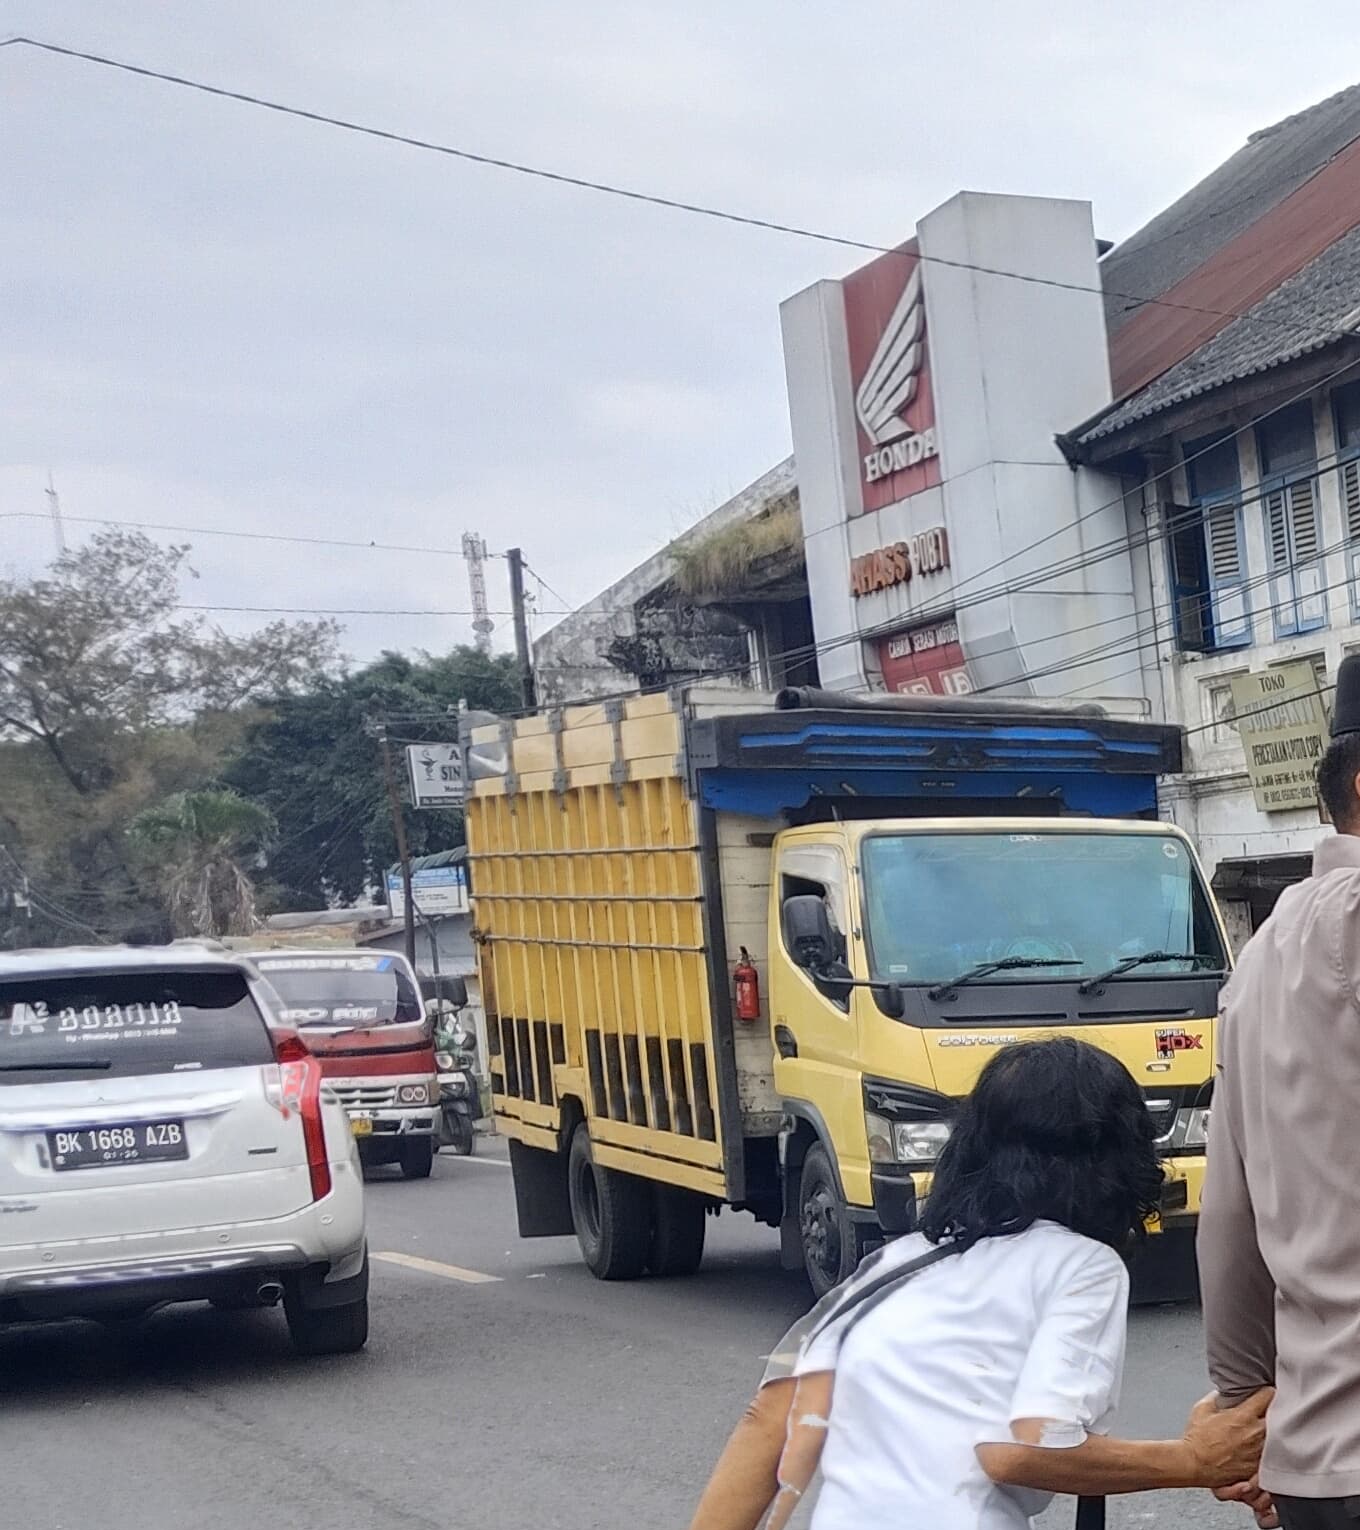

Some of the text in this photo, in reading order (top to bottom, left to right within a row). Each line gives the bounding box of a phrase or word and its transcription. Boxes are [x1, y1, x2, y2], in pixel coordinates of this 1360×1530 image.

[864, 428, 939, 482] HONDA
[1258, 674, 1285, 693] TOKO
[55, 1123, 182, 1154] BK 1668 AZB
